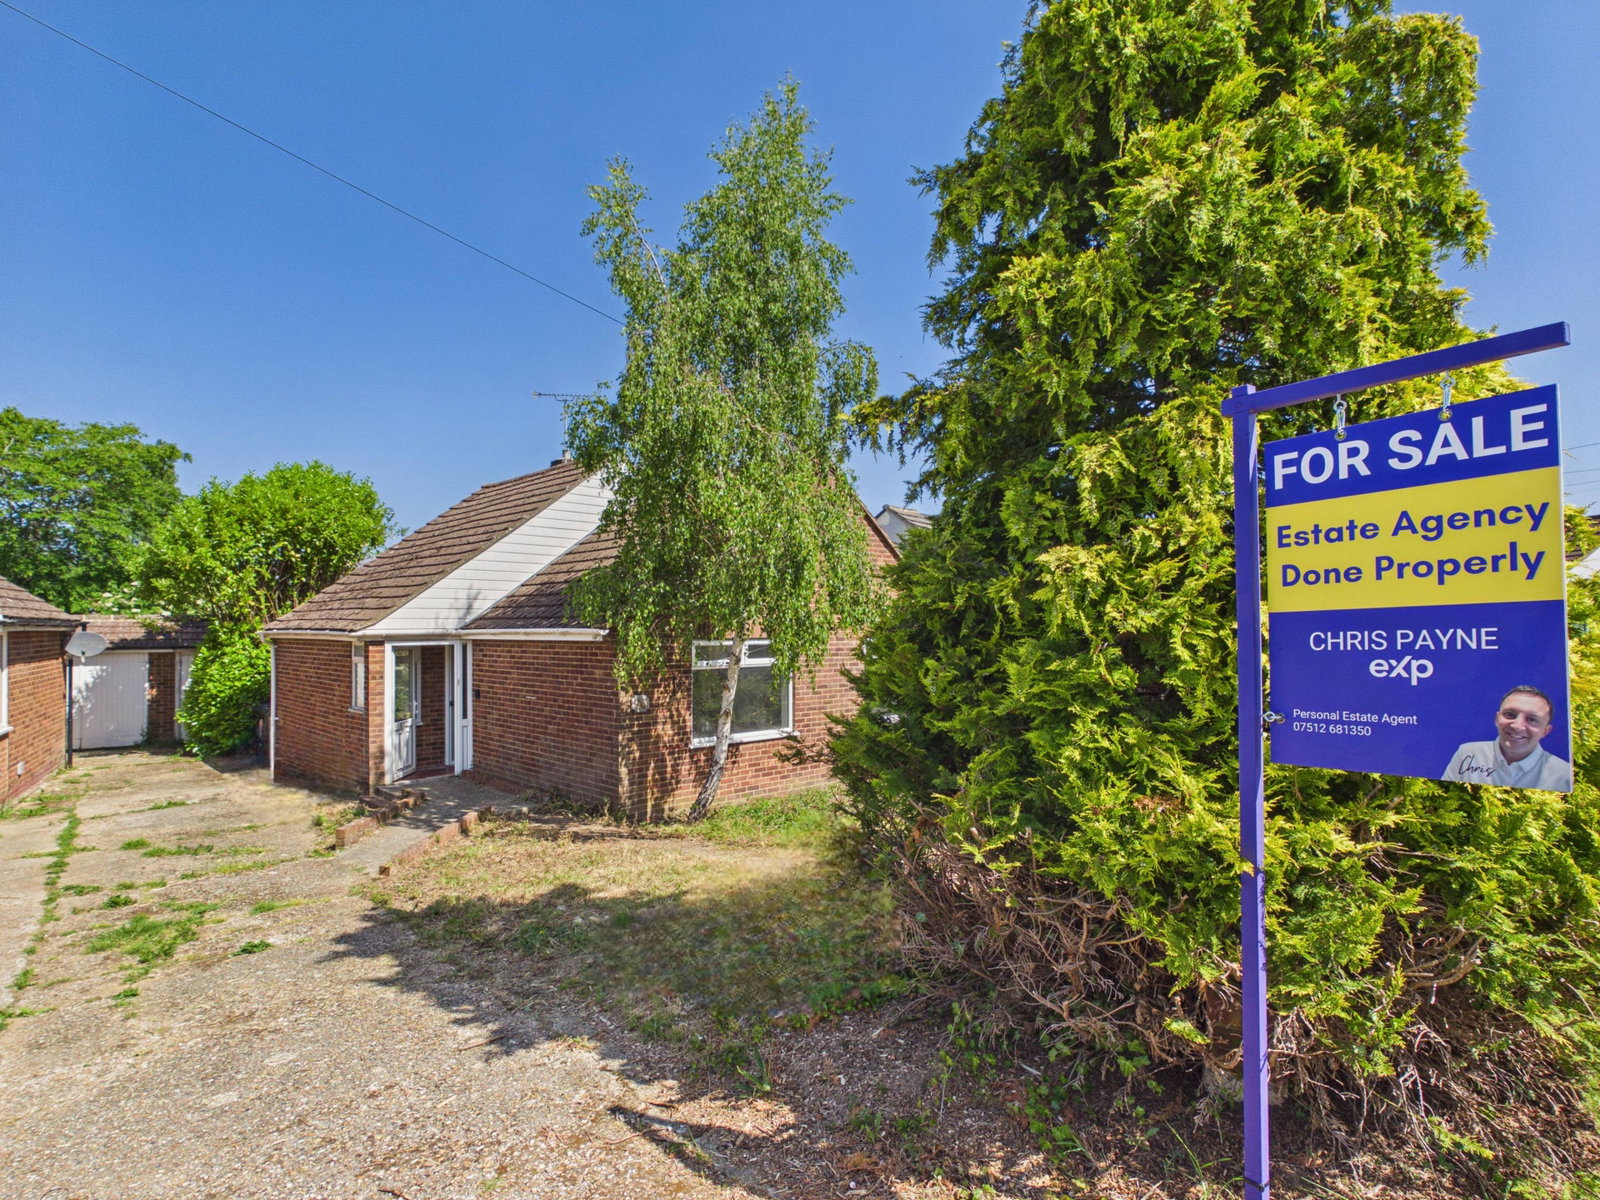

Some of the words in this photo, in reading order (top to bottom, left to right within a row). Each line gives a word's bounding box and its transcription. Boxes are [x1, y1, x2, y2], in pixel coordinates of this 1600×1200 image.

[1273, 439, 1372, 491] FOR
[1388, 403, 1549, 470] SALE
[1277, 519, 1380, 548] Estate
[1391, 502, 1550, 541] Agency
[1281, 563, 1363, 587] Done
[1375, 541, 1546, 585] Properly
[1309, 630, 1388, 651] CHRIS
[1396, 627, 1499, 650] PAYNE
[1293, 708, 1340, 721] Personal
[1343, 711, 1379, 723] Estate
[1381, 714, 1418, 726] Agent
[1293, 722, 1326, 733] 07512
[1329, 724, 1372, 736] 681350
[1458, 754, 1496, 777] Chris
